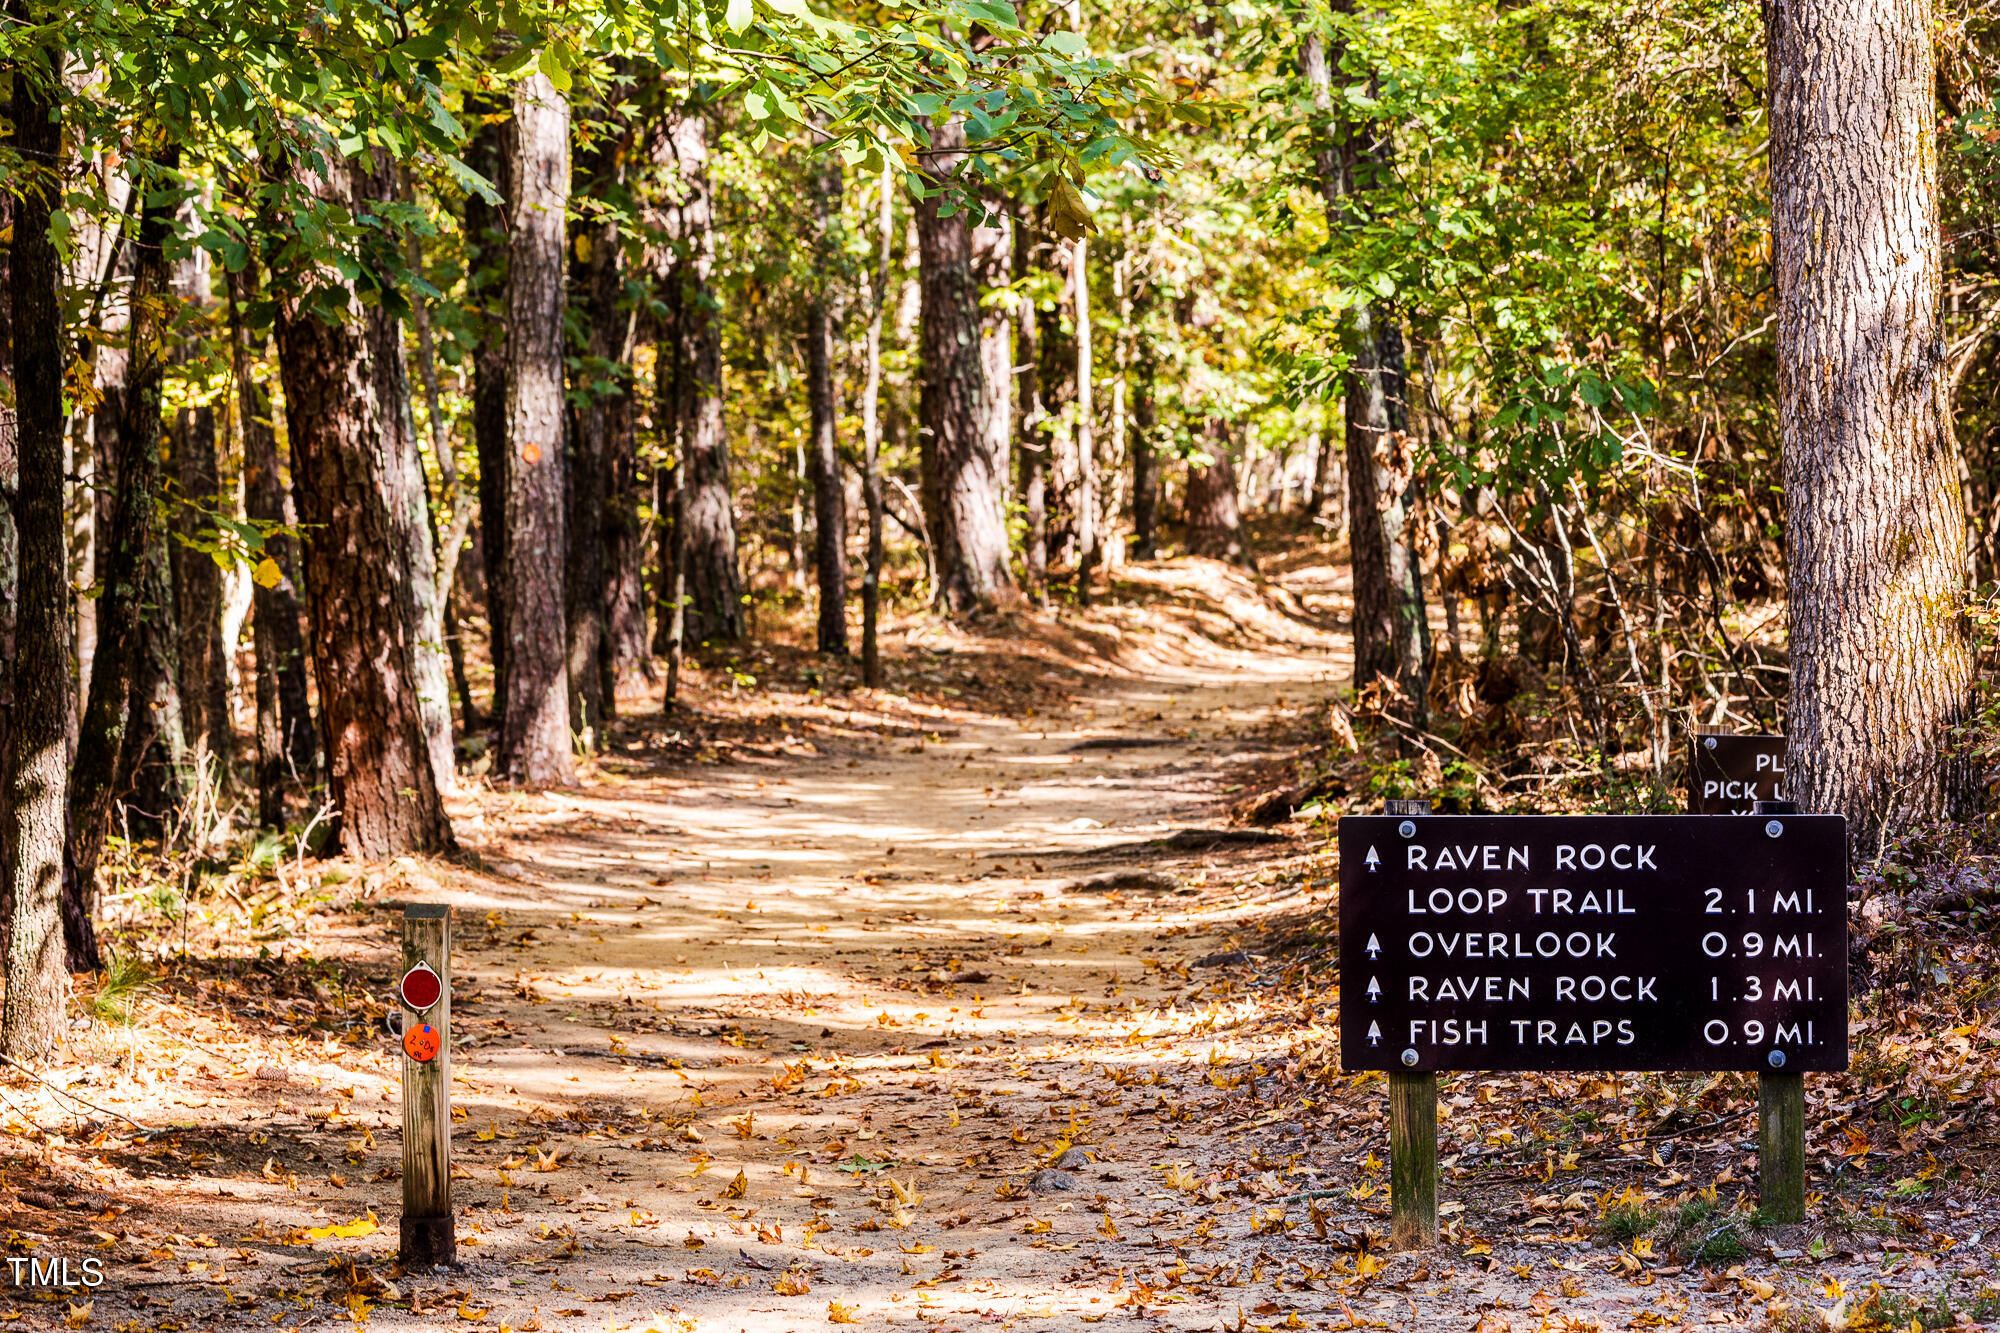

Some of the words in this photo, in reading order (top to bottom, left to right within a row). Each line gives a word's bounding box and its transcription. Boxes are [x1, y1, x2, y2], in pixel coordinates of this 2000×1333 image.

[1704, 780, 1758, 801] PICK
[1407, 844, 1530, 871] RAVEN
[1556, 843, 1658, 871] ROCK
[1408, 887, 1508, 914] LOOP
[1526, 887, 1636, 914] TRAIL
[1704, 887, 1755, 914] 2.1
[1772, 888, 1824, 914] MI.
[1408, 931, 1617, 958] OVERLOOK
[1701, 931, 1764, 958] 0.9
[1773, 932, 1824, 958] MI.
[1408, 975, 1530, 1002] RAVEN
[1556, 975, 1659, 1002] ROCK
[1711, 975, 1763, 1002] 1.3
[1773, 976, 1824, 1002] MI.
[1410, 1018, 1488, 1045] FISH
[1510, 1019, 1636, 1045] TRAPS
[1703, 1019, 1765, 1045] 0.9
[1774, 1020, 1825, 1045] MI.
